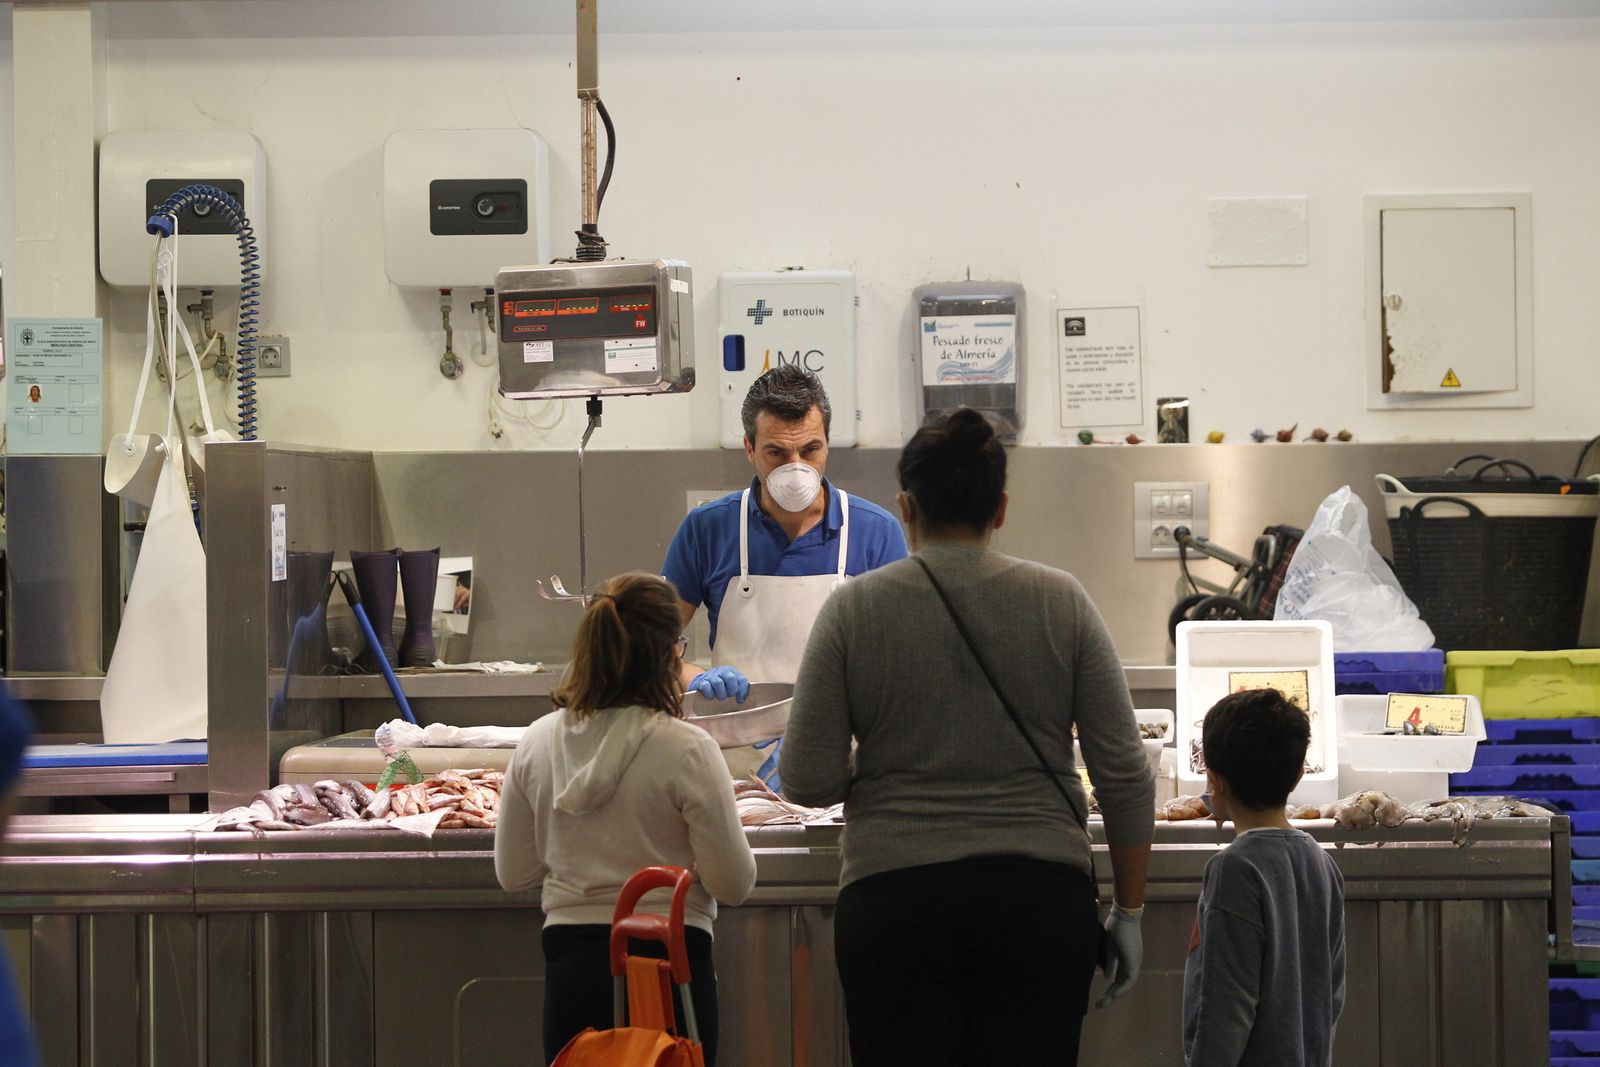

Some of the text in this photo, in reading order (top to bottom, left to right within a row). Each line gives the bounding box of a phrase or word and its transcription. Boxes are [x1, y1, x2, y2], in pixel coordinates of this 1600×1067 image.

[783, 307, 825, 316] BOTIQUÍN
[635, 320, 646, 328] FW
[933, 335, 1004, 346] Pescado fresco
[940, 349, 953, 360] de
[1407, 706, 1423, 726] 4
